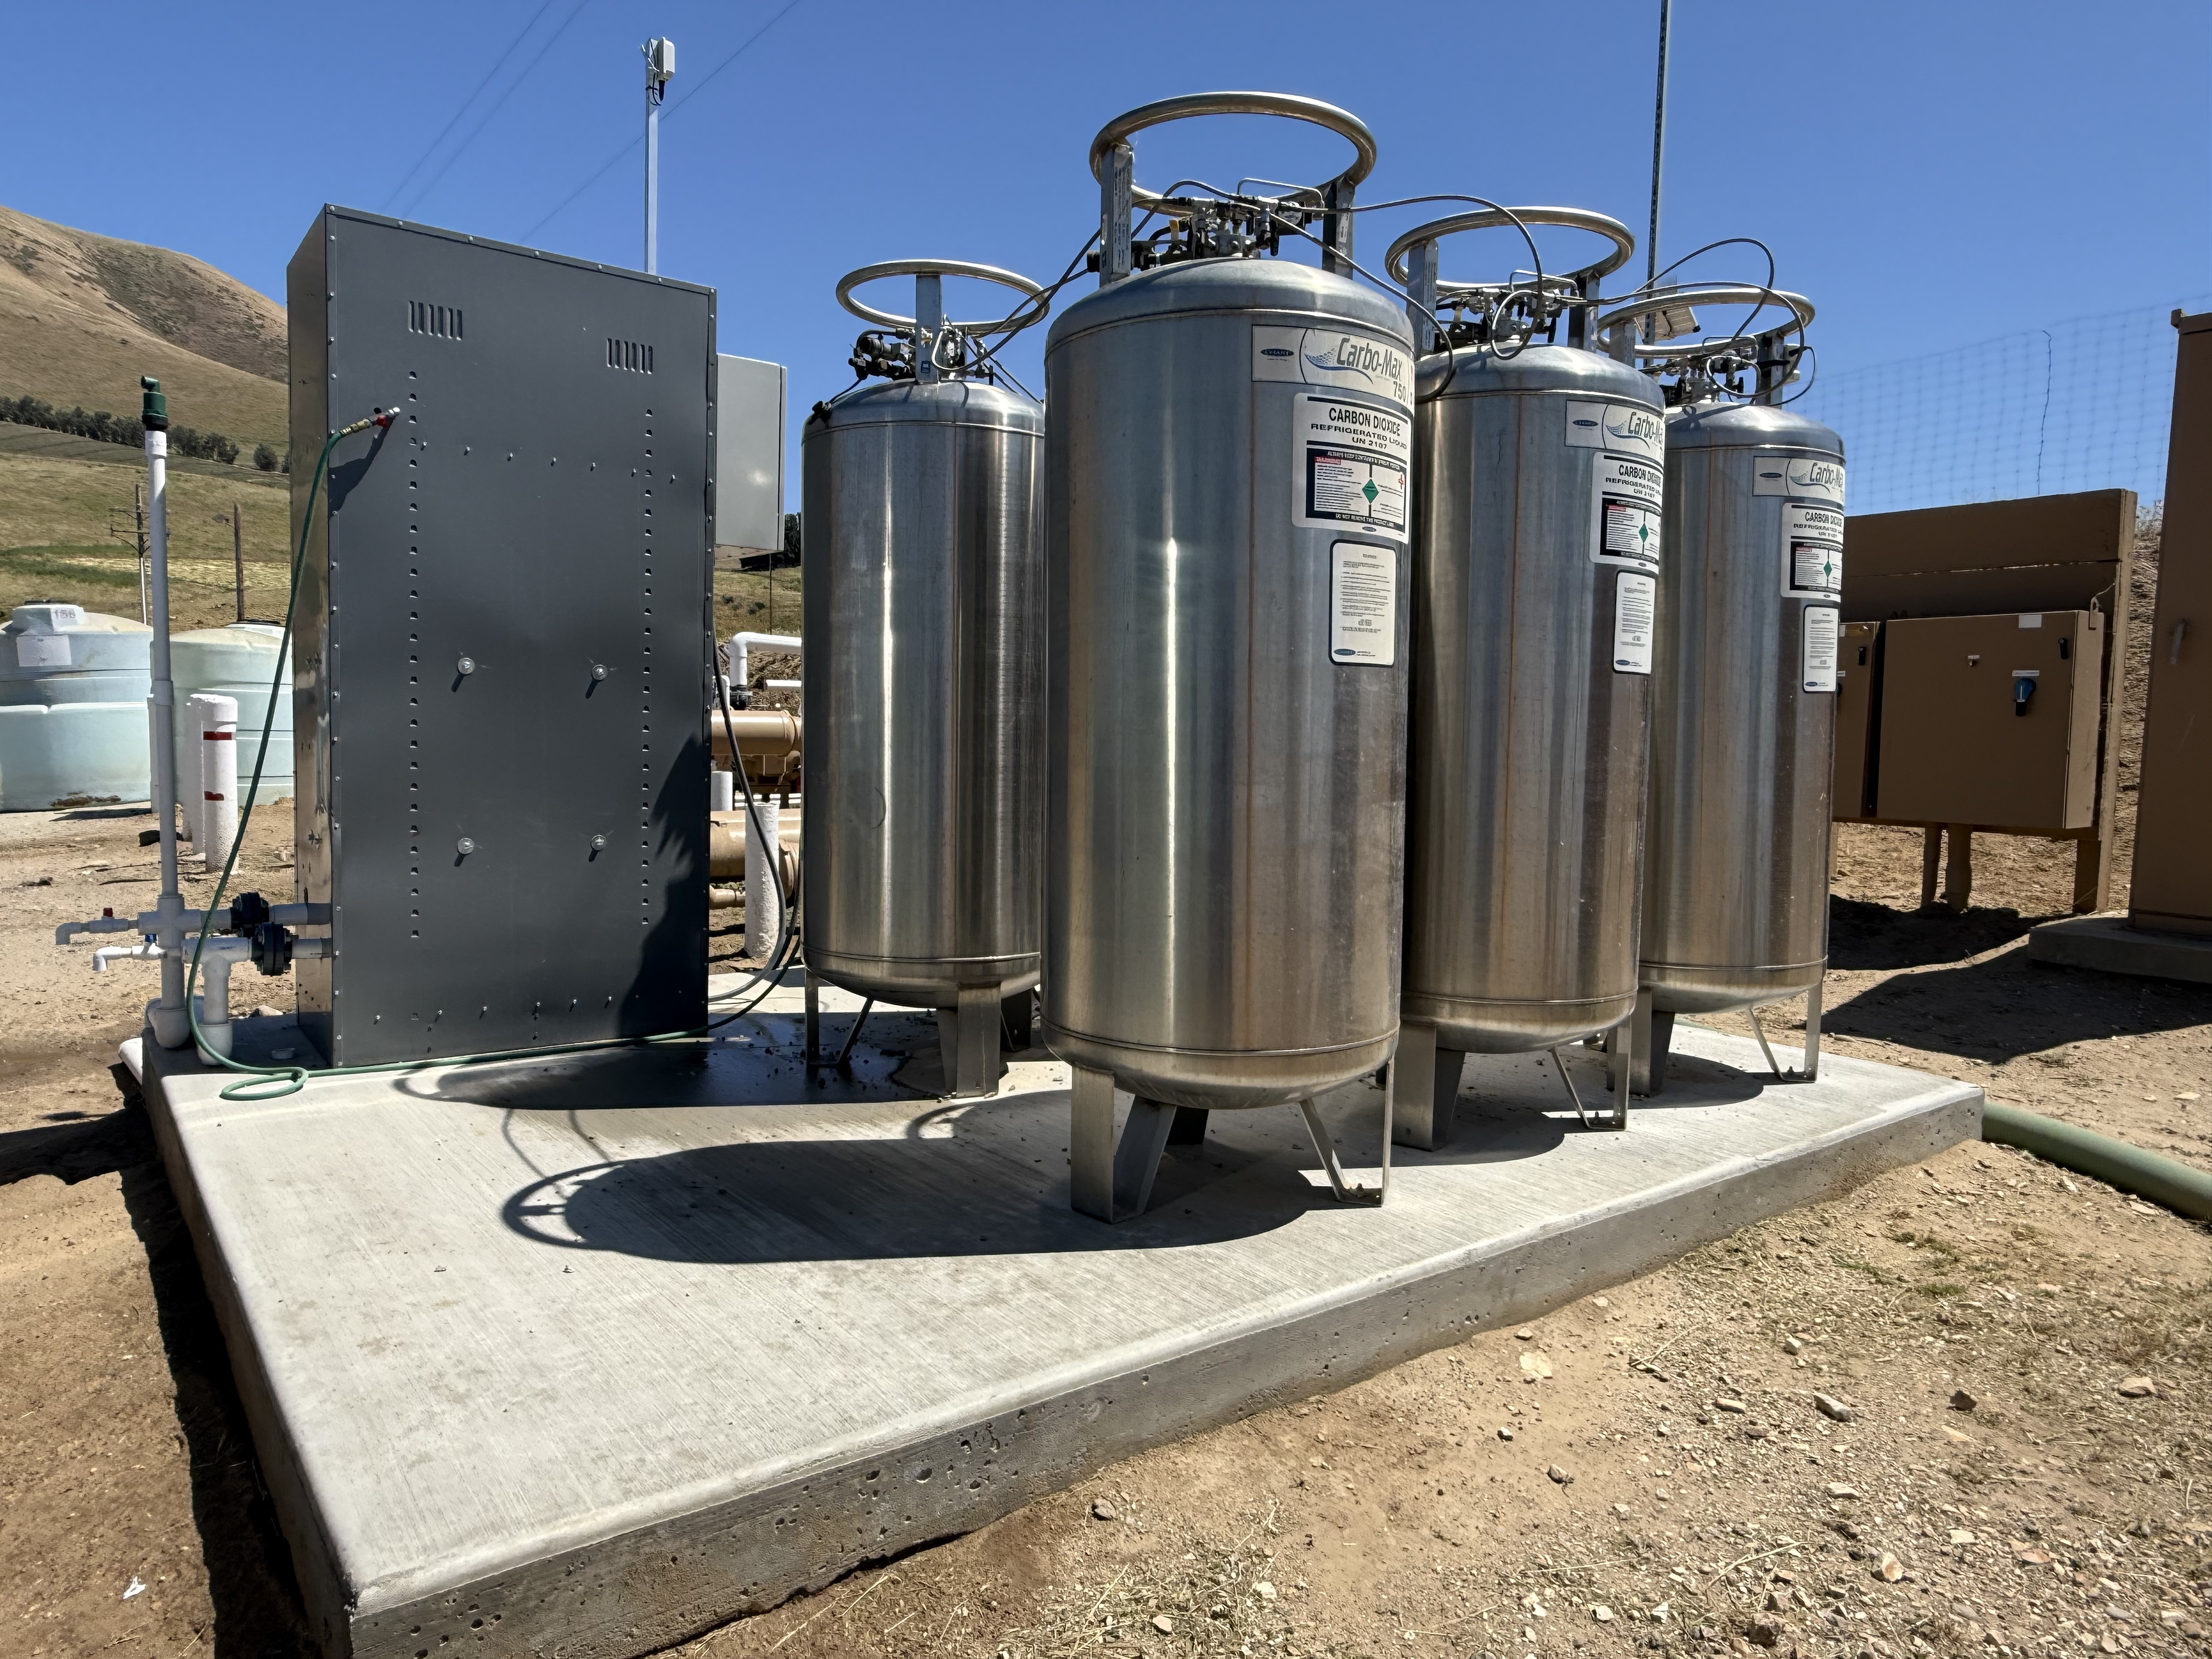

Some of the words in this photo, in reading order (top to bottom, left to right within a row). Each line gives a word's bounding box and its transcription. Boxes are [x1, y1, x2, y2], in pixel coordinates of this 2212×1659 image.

[1336, 335, 1403, 382] Carbo-Max
[1393, 381, 1406, 402] 750
[1311, 423, 1387, 441] REFRIGERATED
[1329, 408, 1370, 427] CARBON
[1373, 415, 1401, 436] DIOXIDE
